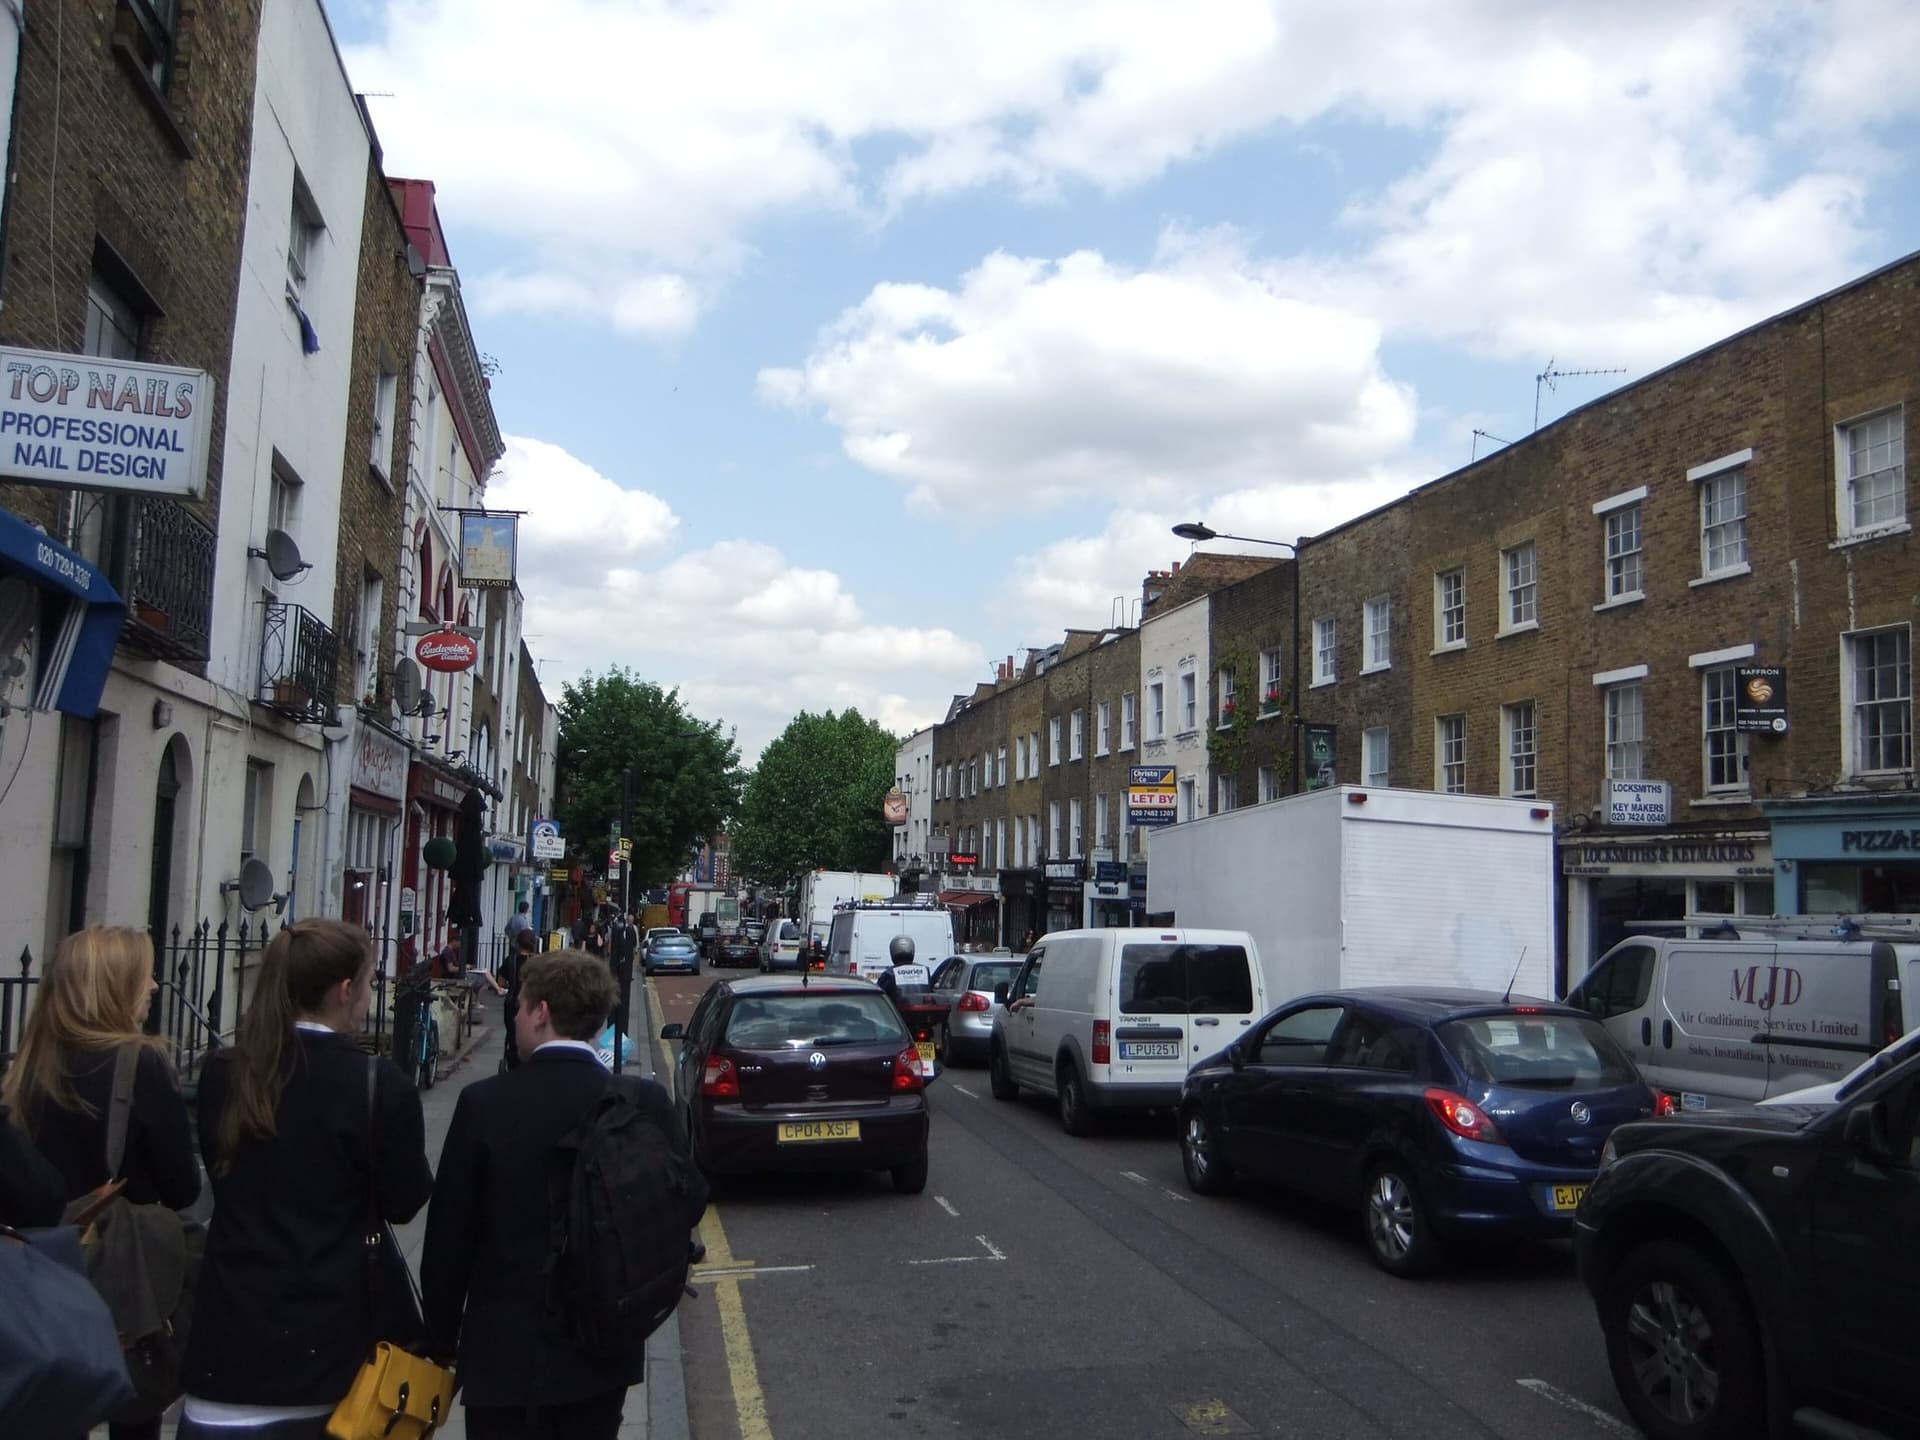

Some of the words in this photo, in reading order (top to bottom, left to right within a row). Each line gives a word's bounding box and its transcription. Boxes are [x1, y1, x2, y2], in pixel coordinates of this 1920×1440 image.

[7, 362, 80, 405] TOP
[87, 371, 194, 419] NAILS
[1, 411, 185, 453] PROFESSIONAL
[14, 442, 69, 470] NAIL
[77, 449, 167, 480] DESIGN
[38, 542, 54, 567] 020
[1612, 783, 1663, 794] LOCKSMITHS
[1634, 793, 1642, 802] &
[1131, 794, 1155, 804] LET
[1158, 794, 1175, 804] BY
[1612, 802, 1629, 812] KEY
[1630, 803, 1664, 813] MAKERS
[1611, 812, 1626, 821] 020
[1627, 812, 1645, 822] 7424
[1646, 813, 1666, 823] 0040
[1583, 846, 1656, 864] LOCKSMITHS
[897, 967, 923, 975] courier
[1729, 965, 1803, 1011] MJD
[1679, 1011, 1694, 1023] Air
[1697, 1012, 1761, 1032] Conditioning
[1762, 1016, 1808, 1033] Services
[1811, 1019, 1858, 1036] Limited
[1713, 1046, 1765, 1064] Installation
[1778, 1053, 1844, 1071] Maintenance
[1126, 1064, 1133, 1073] H
[784, 1122, 823, 1139] CP04
[826, 1121, 853, 1137] XSF
